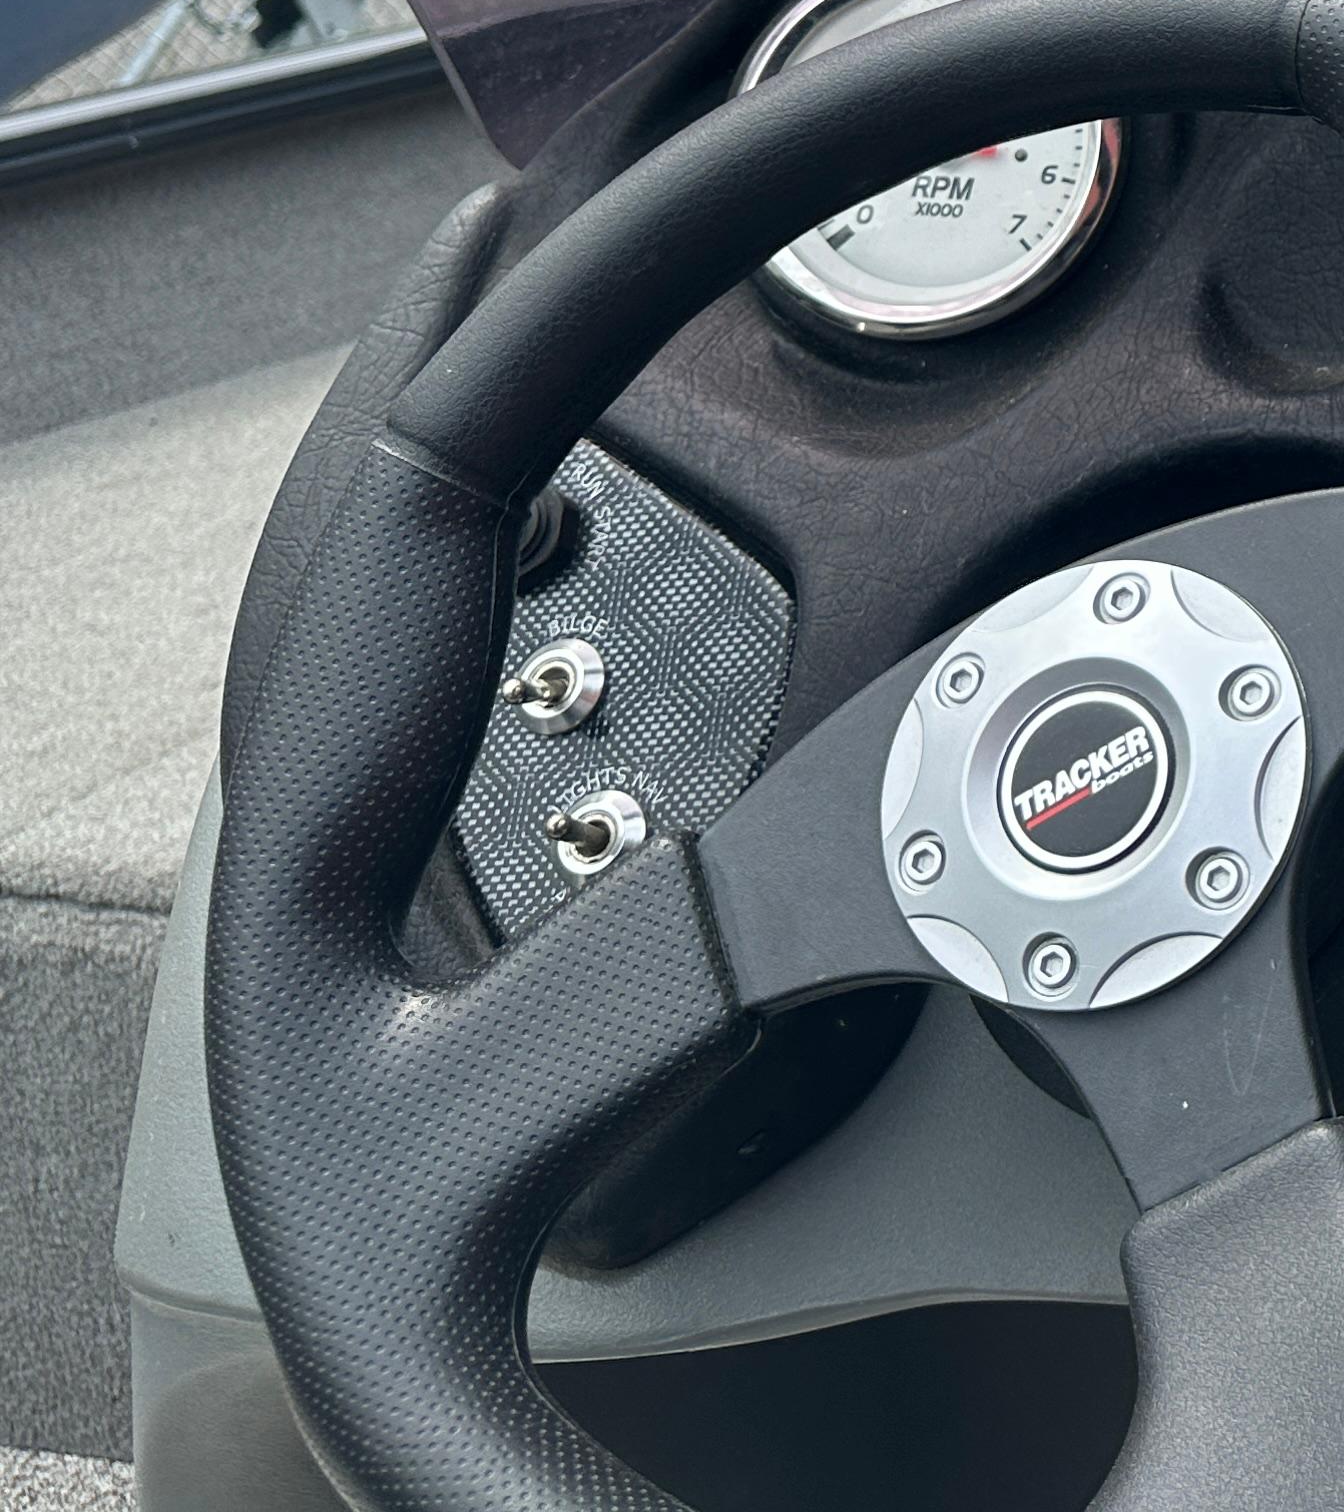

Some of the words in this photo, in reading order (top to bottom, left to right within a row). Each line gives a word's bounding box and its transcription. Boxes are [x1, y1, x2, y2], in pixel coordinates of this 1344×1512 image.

[911, 175, 976, 202] RPM
[1040, 164, 1059, 185] 6
[856, 204, 875, 225] 0
[1009, 214, 1027, 235] 7
[570, 463, 606, 501] RUN
[585, 505, 612, 571] START
[548, 614, 610, 638] BILGE
[631, 770, 669, 804] NAV
[1014, 726, 1150, 820] TRACKER
[1090, 751, 1154, 795] boats
